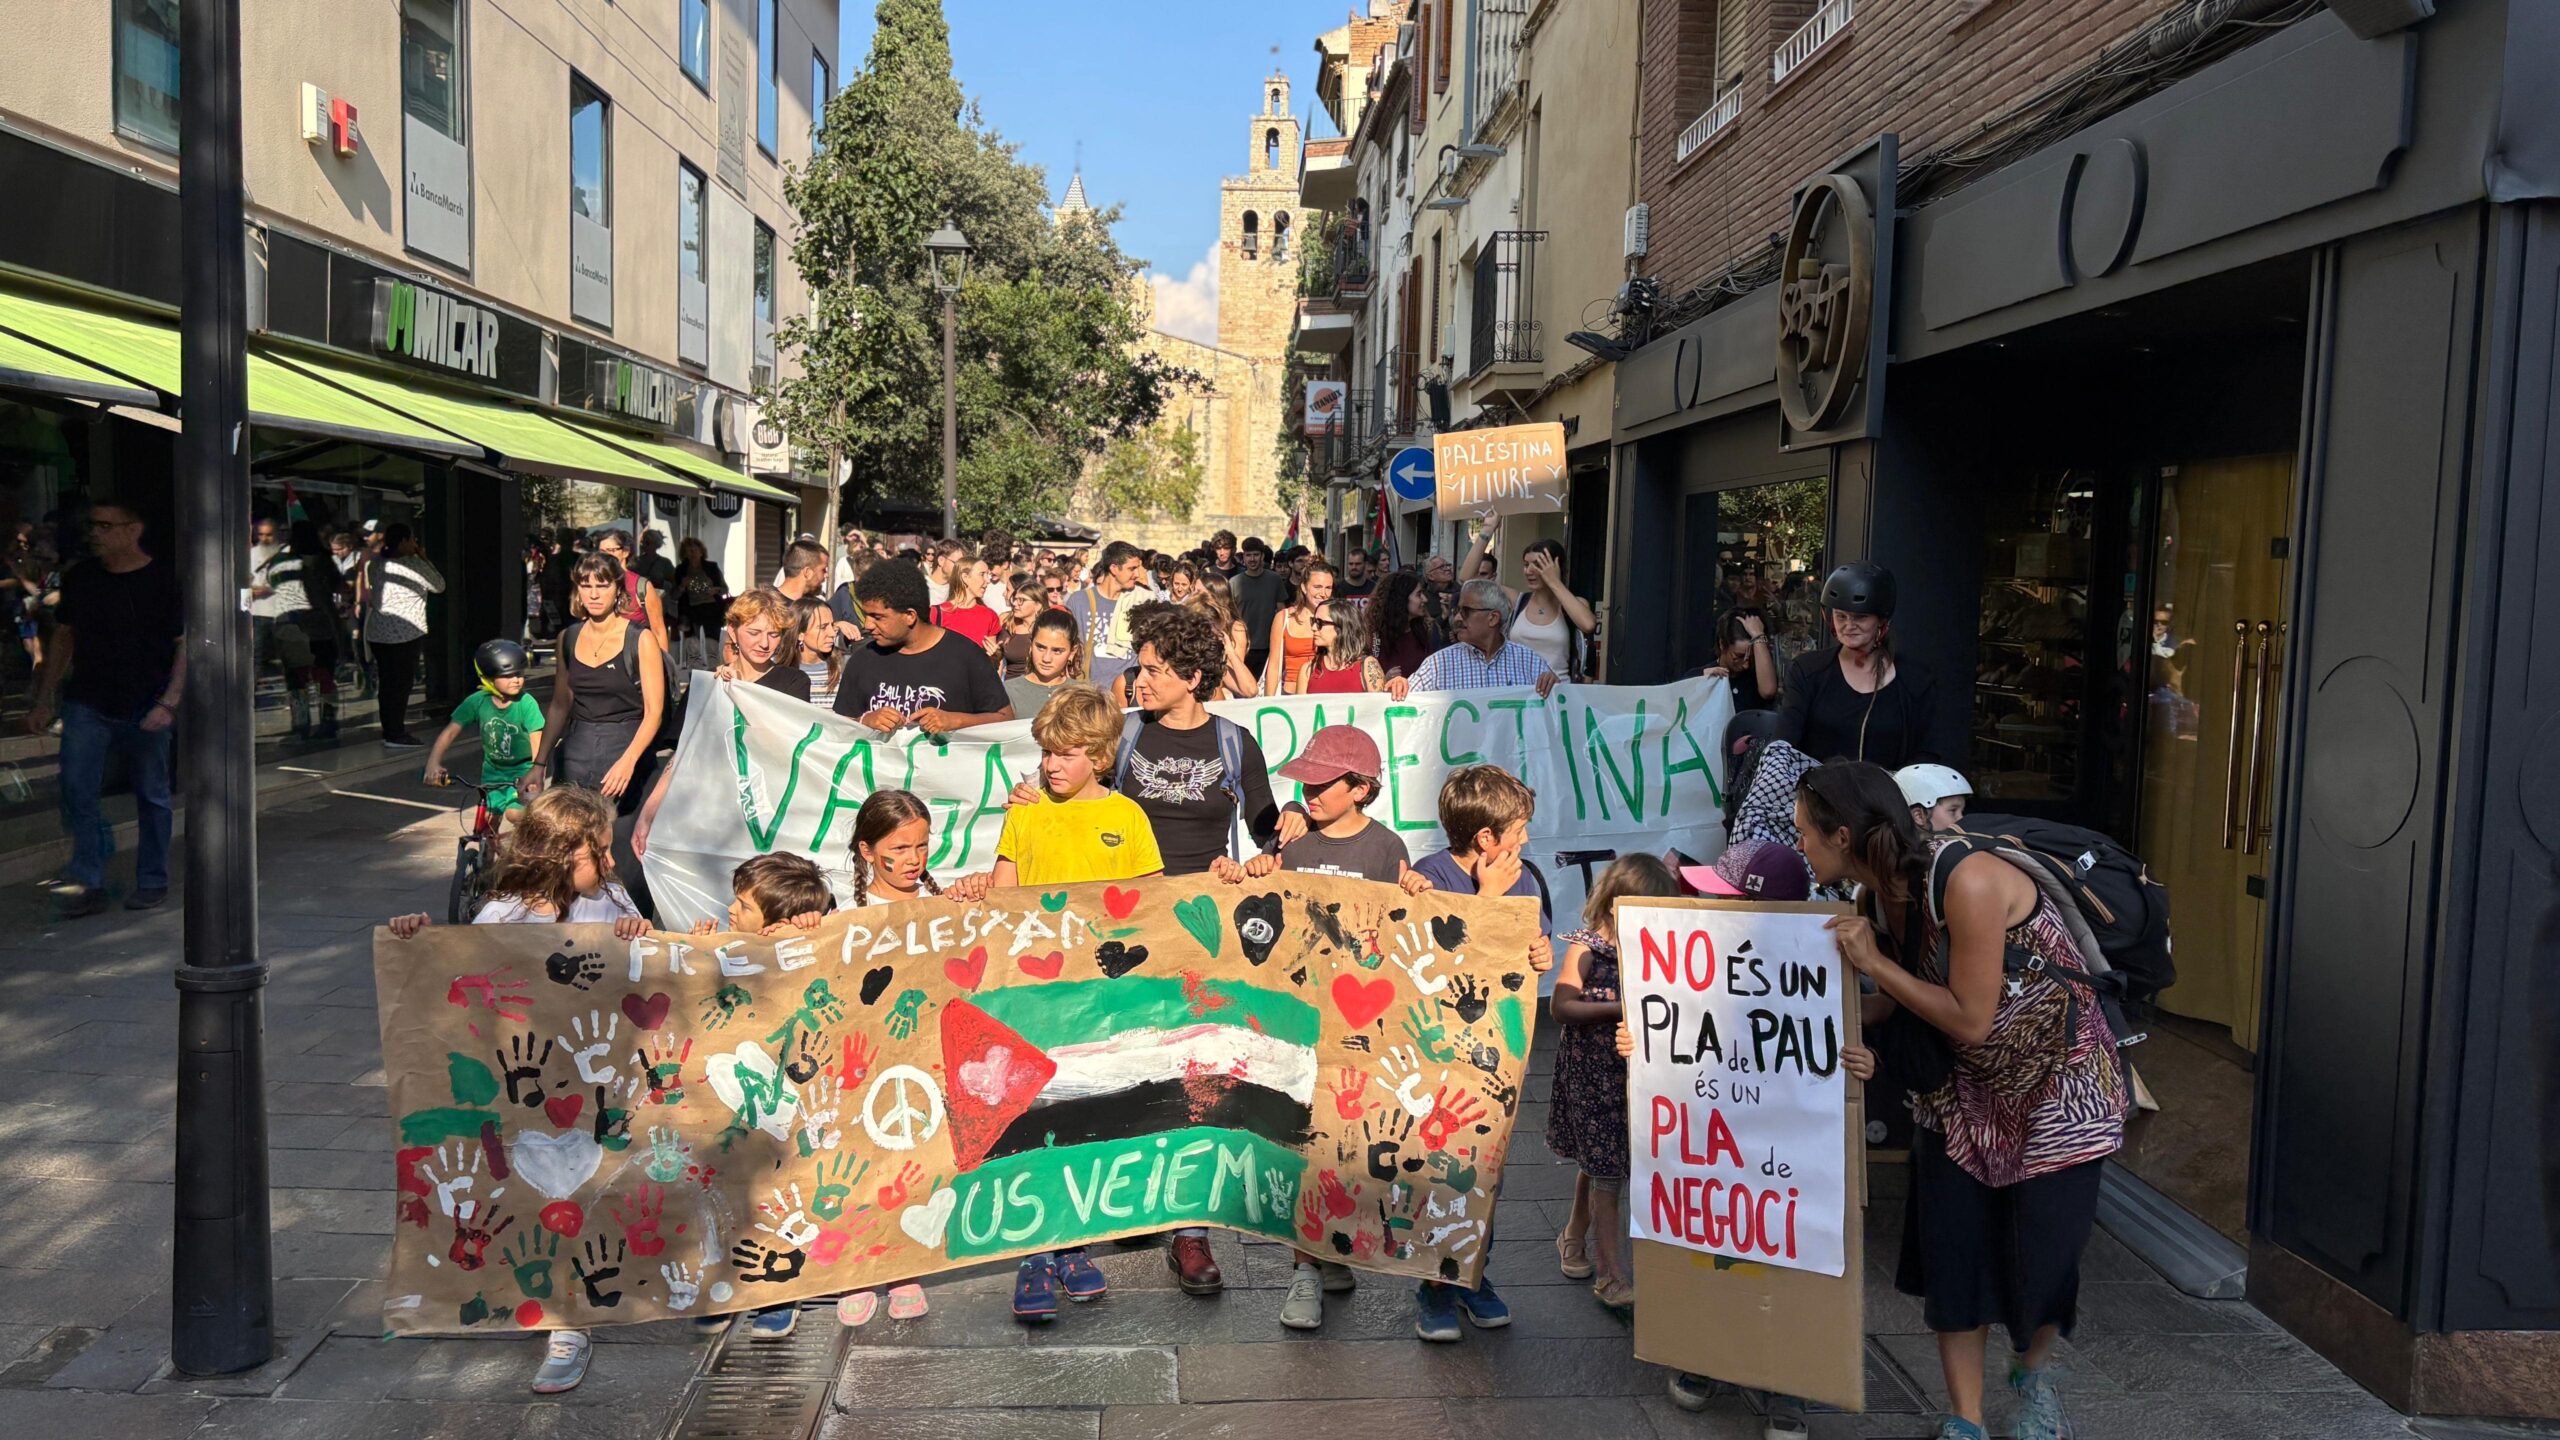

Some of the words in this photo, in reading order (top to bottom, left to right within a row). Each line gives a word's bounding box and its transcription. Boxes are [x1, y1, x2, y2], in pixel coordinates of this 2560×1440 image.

[412, 285, 499, 379] MILAR
[1443, 438, 1553, 469] PALESTINA
[1458, 467, 1535, 506] LLIURE
[877, 682, 902, 702] BALL
[905, 685, 918, 702] DE
[628, 934, 817, 983] FREE
[1639, 927, 1716, 992] NO
[1727, 939, 1772, 996] ÉS
[1779, 960, 1827, 1000] UN
[1641, 994, 1723, 1065] PLA
[1728, 1039, 1750, 1074] de
[1746, 1008, 1839, 1079] PAU
[1694, 1071, 1720, 1099] és
[1731, 1081, 1760, 1105] UN
[1651, 1094, 1744, 1169] PLA
[1760, 1145, 1793, 1179] de
[961, 1171, 1044, 1246] US
